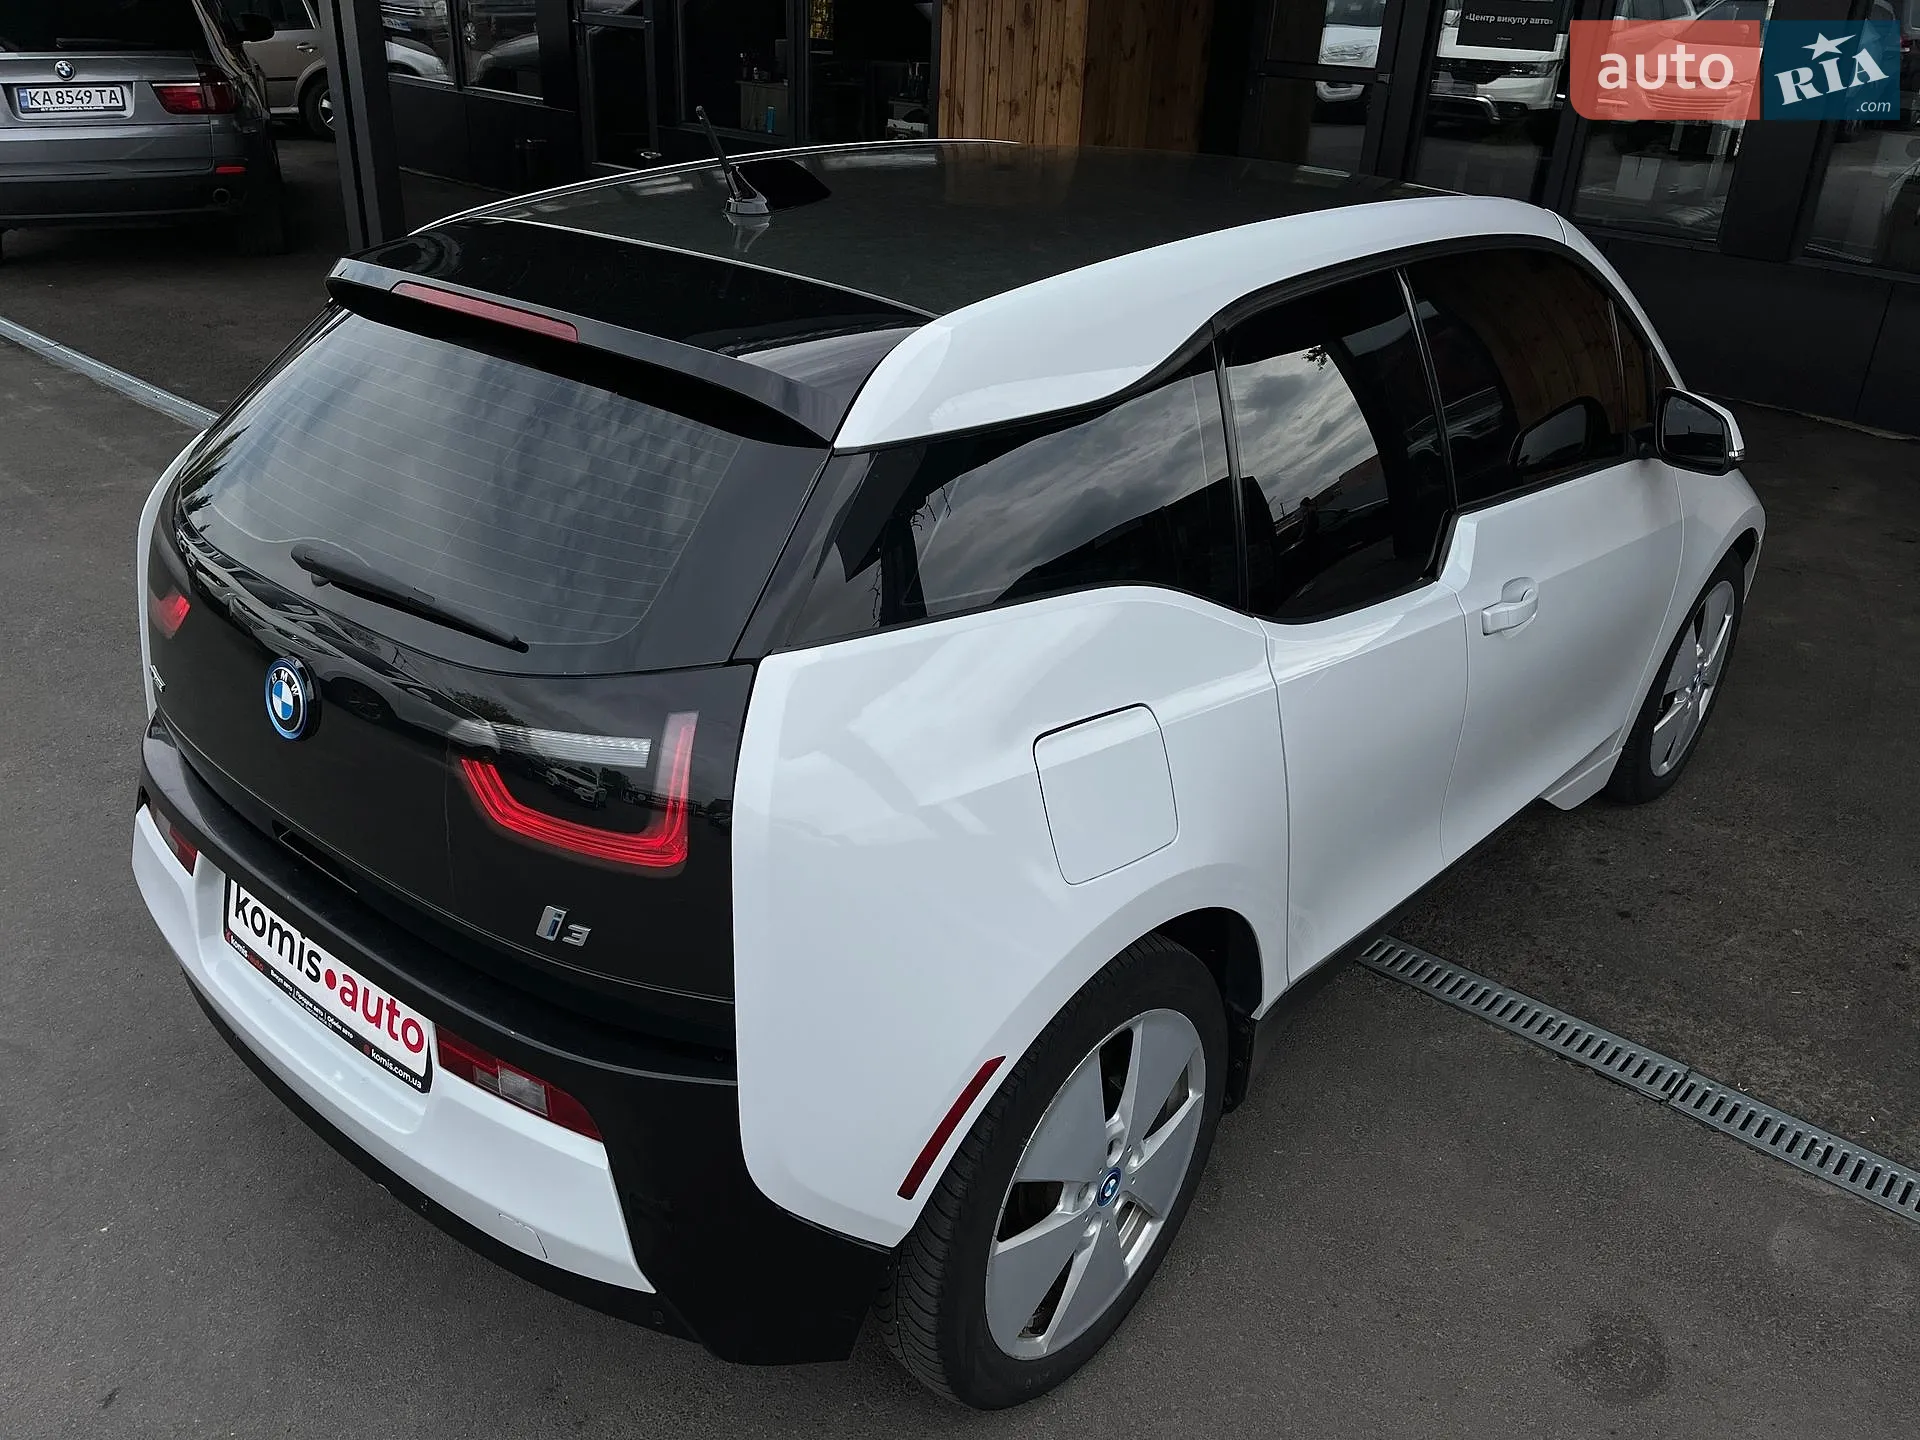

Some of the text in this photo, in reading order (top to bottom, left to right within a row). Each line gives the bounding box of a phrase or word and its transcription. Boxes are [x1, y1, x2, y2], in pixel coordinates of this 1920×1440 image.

[1497, 16, 1527, 25] викупу
[28, 90, 53, 106] KA
[55, 89, 92, 105] 8549
[95, 89, 120, 104] TA
[371, 1048, 422, 1089] komis.com.ua
